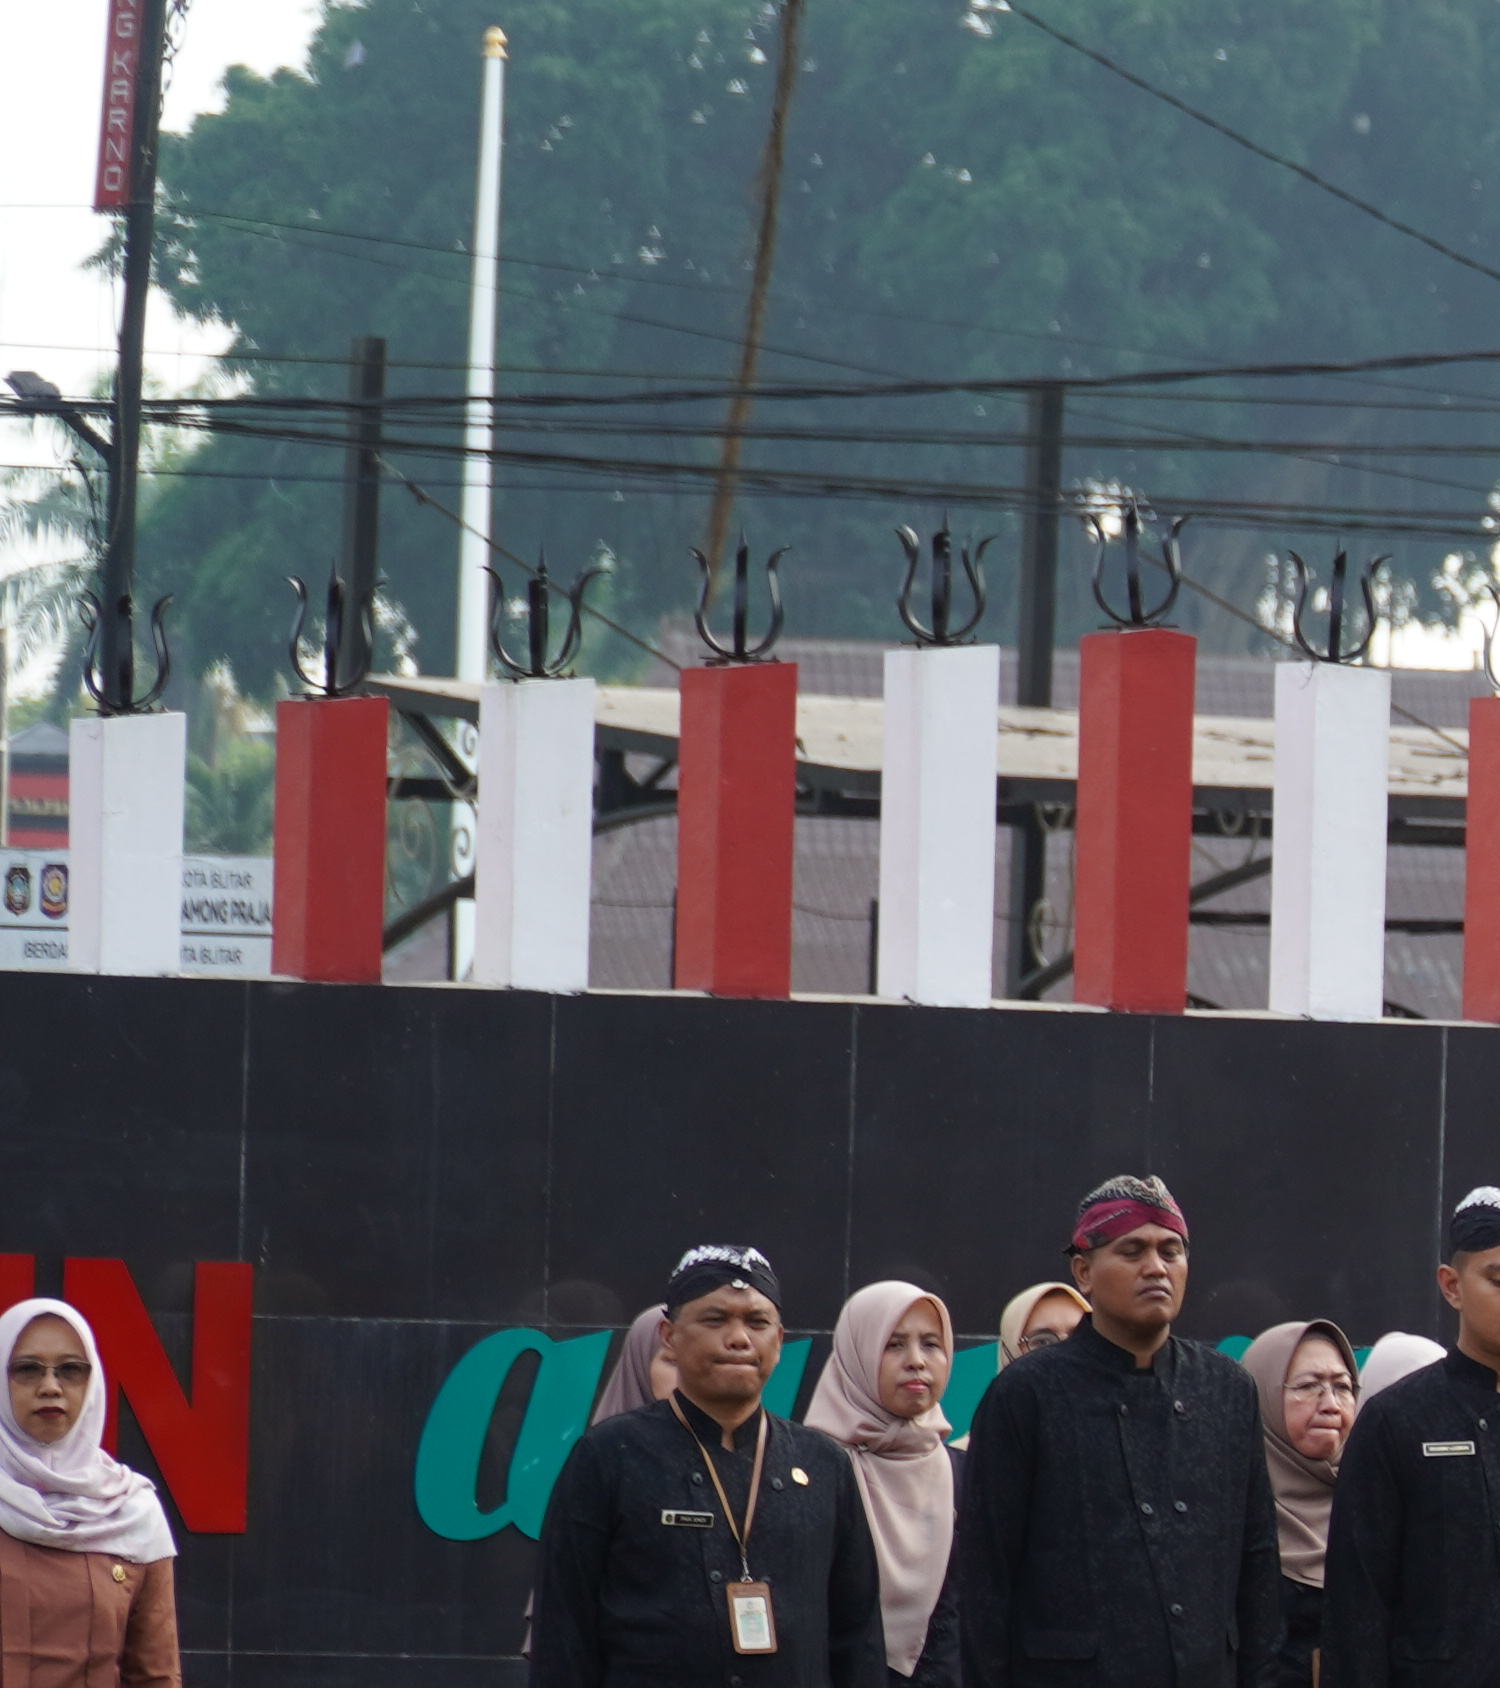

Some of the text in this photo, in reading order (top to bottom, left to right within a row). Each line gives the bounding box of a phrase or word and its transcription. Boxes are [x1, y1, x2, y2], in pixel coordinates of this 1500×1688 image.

[104, 49, 133, 192] KARNO
[210, 869, 252, 889] BLITAR
[200, 945, 243, 964] BLITAR
